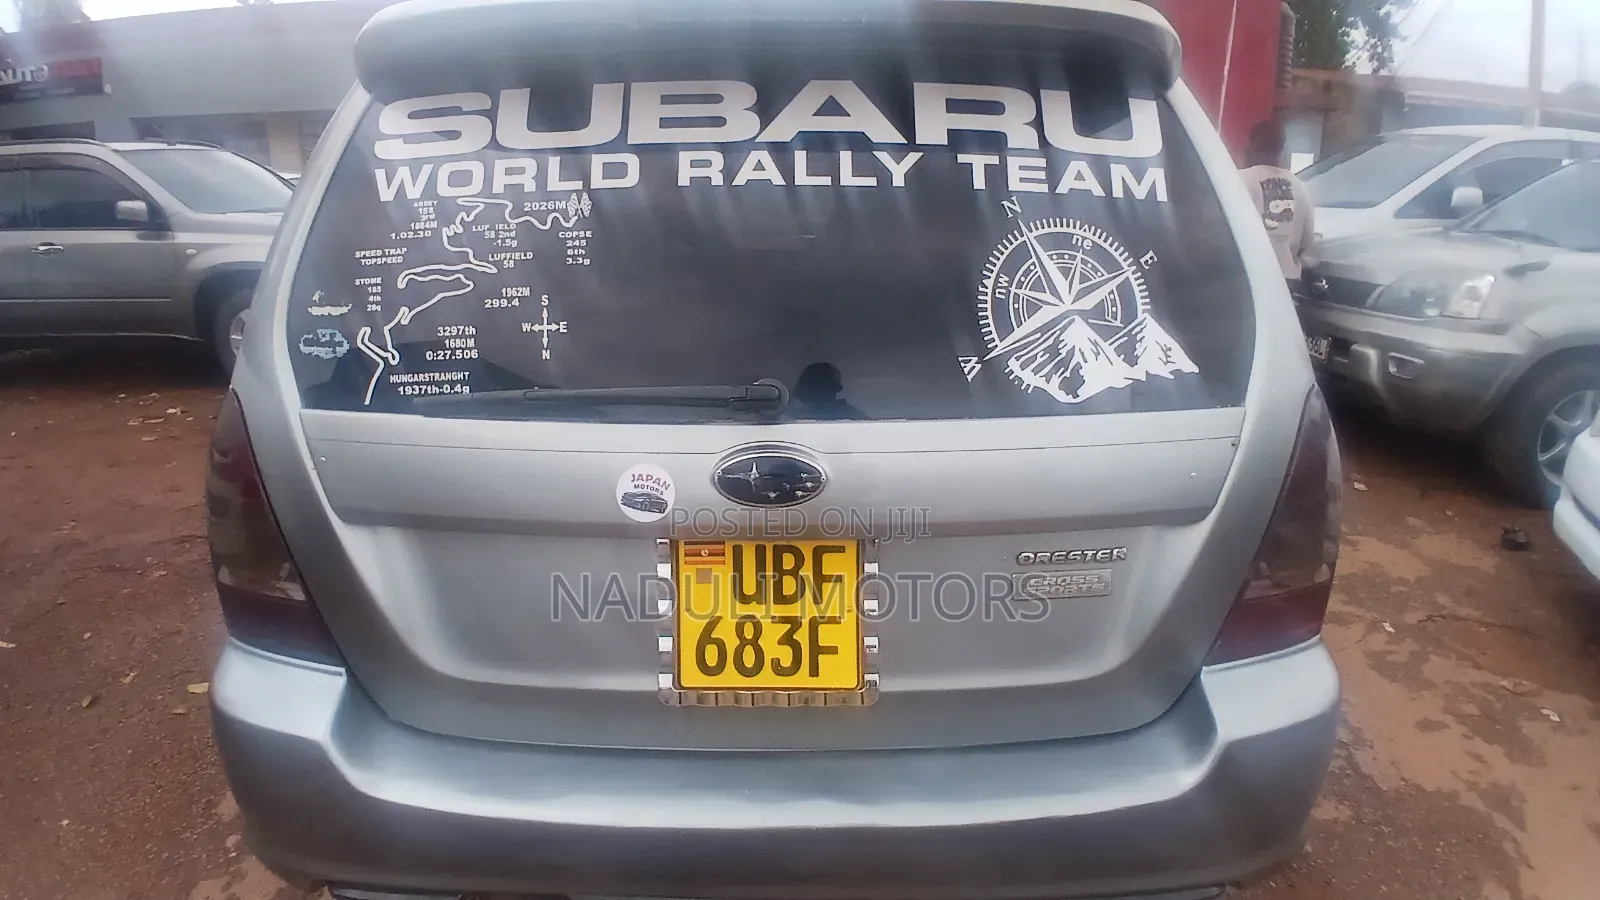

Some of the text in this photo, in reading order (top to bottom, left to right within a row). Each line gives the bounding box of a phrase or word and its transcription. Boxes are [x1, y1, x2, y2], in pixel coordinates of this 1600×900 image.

[374, 80, 1163, 160] SUBARU
[374, 150, 1168, 202] WORLD RALLY TEAM
[523, 200, 567, 212] 2026M
[1001, 196, 1022, 218] N
[484, 230, 516, 239] 58 2nd
[558, 230, 593, 239] COPSE
[565, 239, 587, 247] 245
[1071, 234, 1093, 250] ne
[354, 247, 408, 258] SPEED TRAP
[488, 251, 533, 261] LUFFIELD
[567, 248, 586, 256] 6th
[360, 255, 404, 266] TOPSPEED
[503, 260, 515, 268] 58
[566, 257, 591, 266] 3.3g
[1139, 250, 1158, 269] E
[501, 286, 531, 298] 1962M
[484, 298, 520, 309] 299.4
[541, 294, 549, 306] S
[437, 325, 477, 336] 3297th
[521, 322, 531, 332] W
[560, 321, 568, 333] E
[444, 337, 475, 348] 1680M
[425, 348, 479, 360] 0:27.506
[542, 349, 551, 360] N
[397, 383, 471, 396] 1937th-0.4g
[630, 473, 671, 491] JAPAN
[633, 483, 664, 496] MOTORS
[1017, 547, 1127, 566] ORESTER
[732, 544, 846, 605] UBF
[1029, 574, 1100, 587] CROSS
[695, 614, 842, 678] 683F
